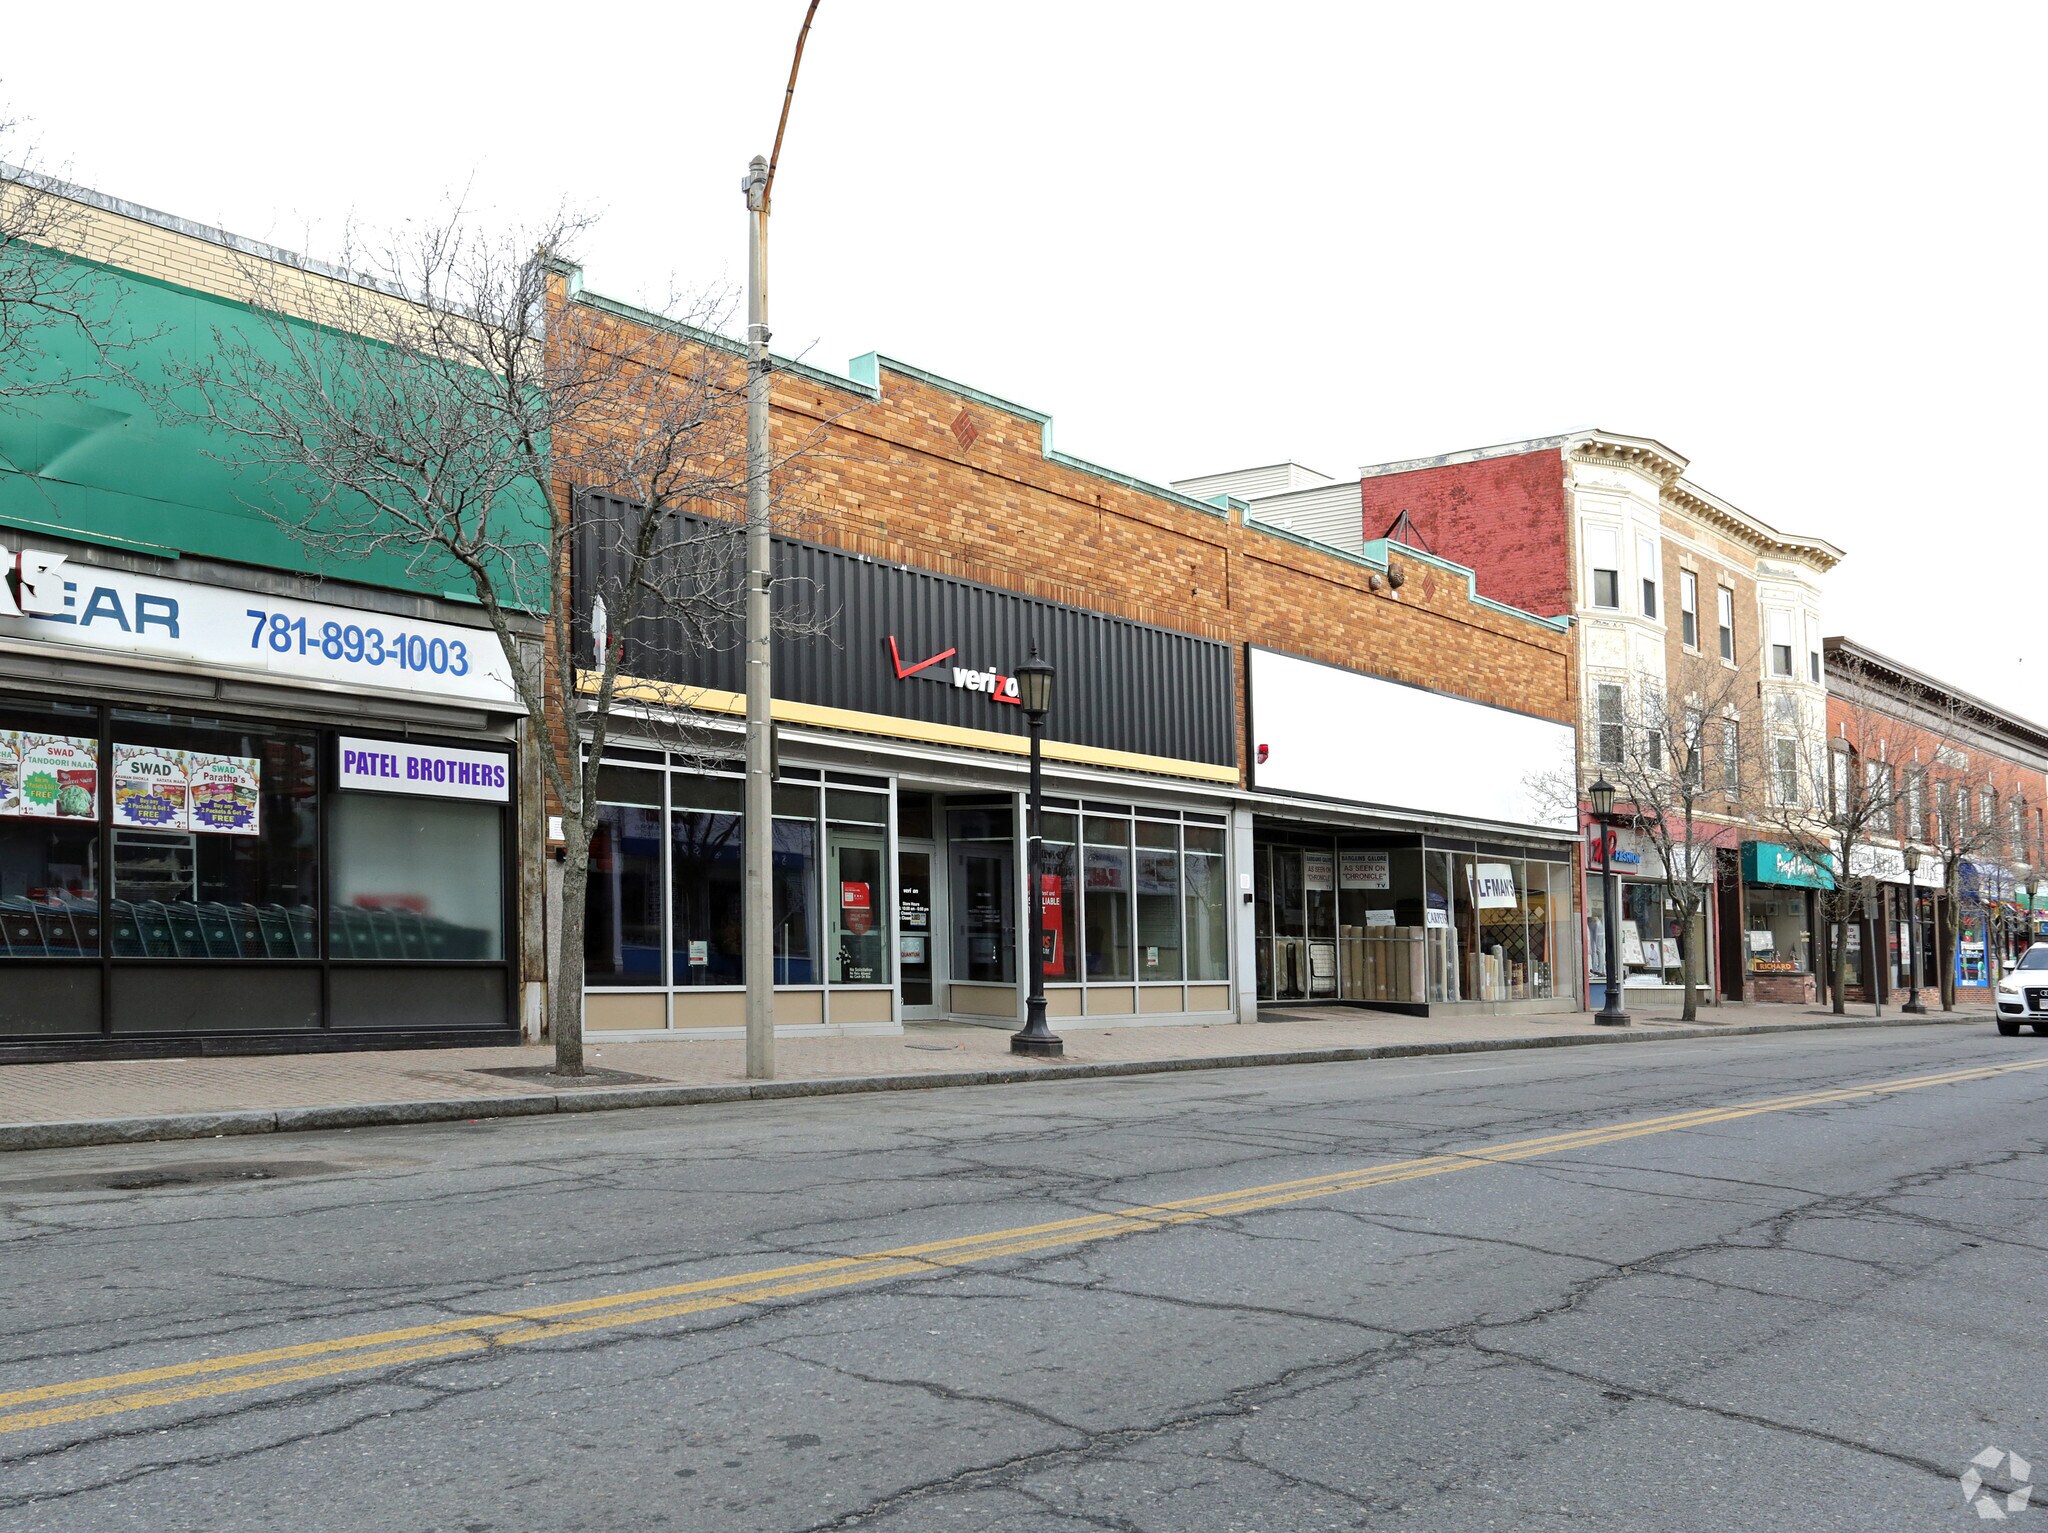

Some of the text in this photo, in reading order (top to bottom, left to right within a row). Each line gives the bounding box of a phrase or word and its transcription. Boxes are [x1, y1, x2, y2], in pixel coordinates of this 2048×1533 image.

[247, 610, 468, 677] 781-893-1003
[953, 667, 1021, 705] verizo
[47, 747, 74, 757] SWAD
[28, 756, 94, 769] TANDOORI NAAN
[131, 761, 172, 776] SWAD
[212, 765, 236, 774] SWAD
[344, 750, 505, 788] PATEL BROTHERS
[203, 771, 246, 784] Paratha's
[30, 790, 52, 799] FREE
[138, 810, 160, 818] FREE
[206, 807, 227, 815] Packets
[212, 814, 235, 823] FREE
[1342, 872, 1387, 881] "CHRONICLE"
[1041, 897, 1060, 906] LIABLE
[1760, 962, 1792, 970] RICHARD
